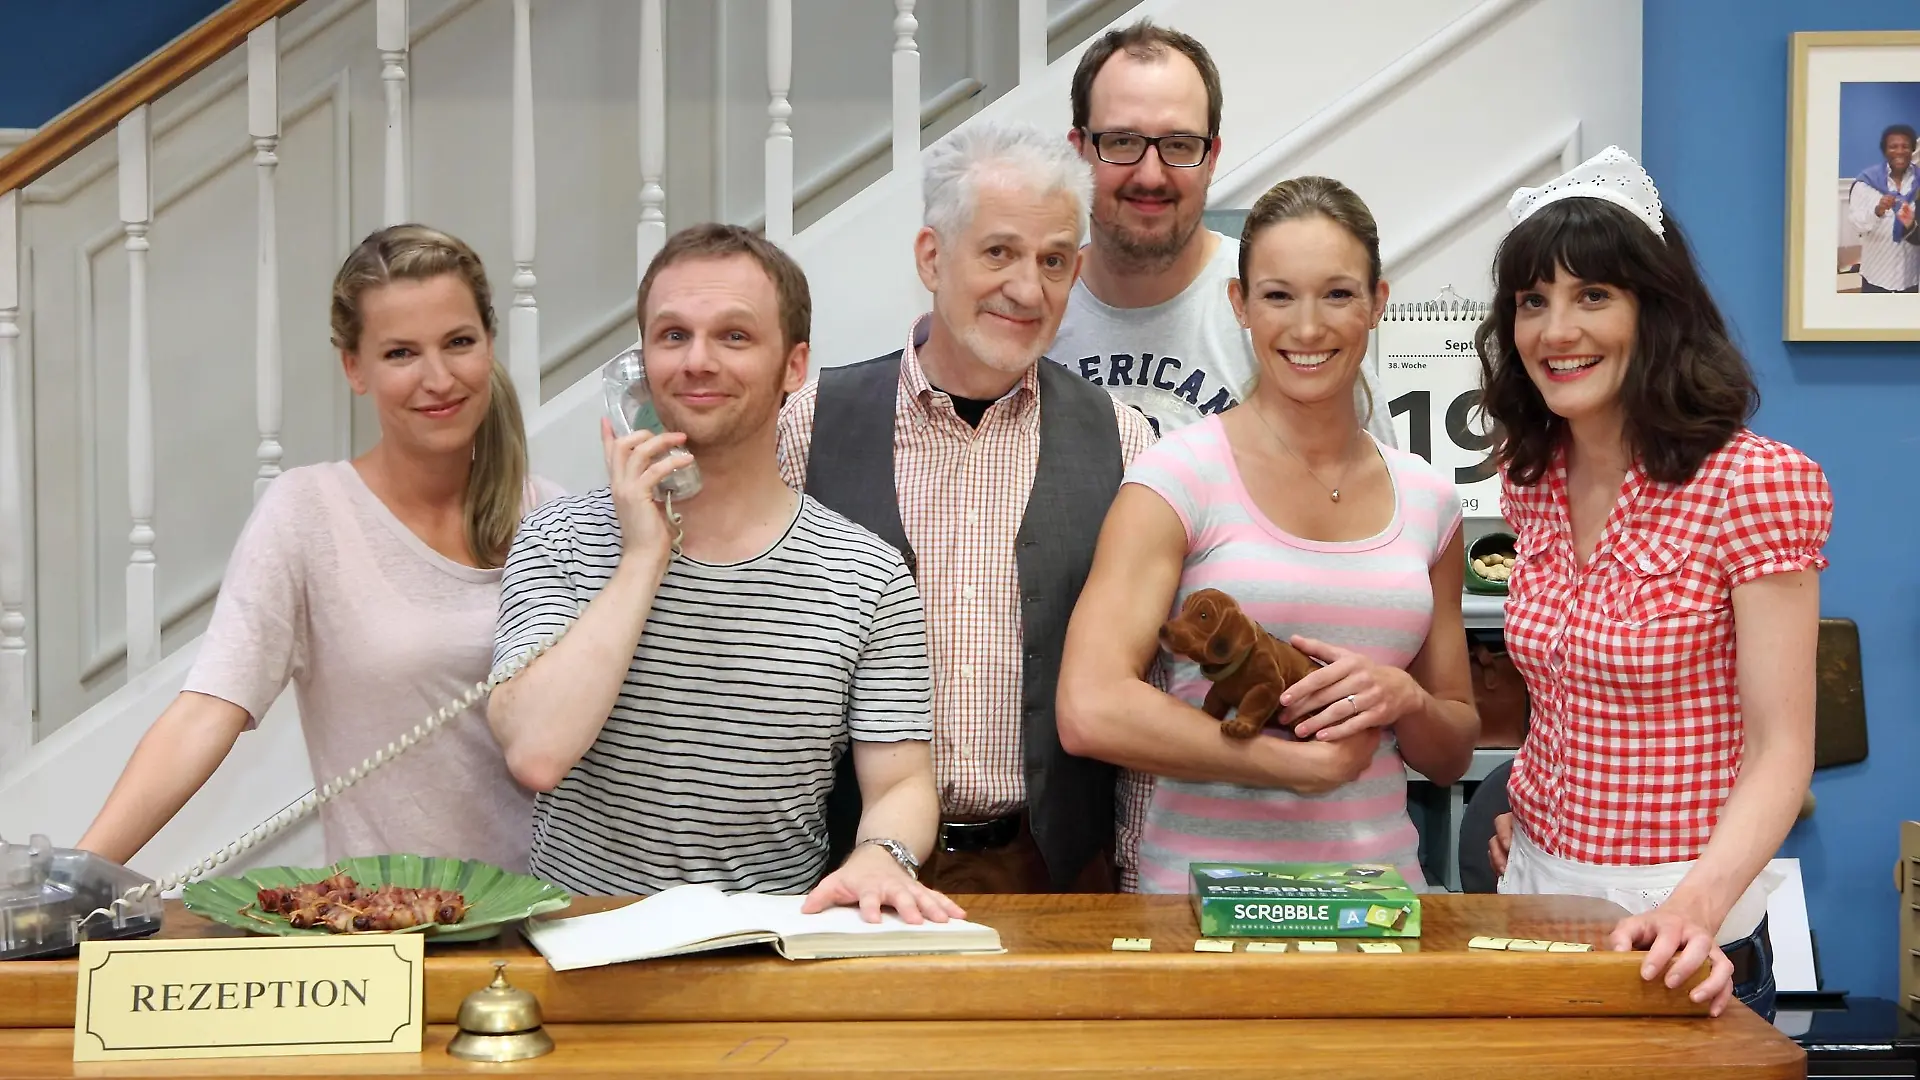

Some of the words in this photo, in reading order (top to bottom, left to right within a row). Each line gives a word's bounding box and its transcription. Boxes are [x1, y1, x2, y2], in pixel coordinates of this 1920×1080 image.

[1445, 339, 1475, 354] Sept
[1388, 362, 1400, 370] 38.
[1401, 362, 1427, 370] Woche
[1063, 353, 1240, 416] ERICAN
[1388, 389, 1499, 484] 19
[1461, 498, 1479, 511] ag
[1234, 904, 1329, 922] SCRABBLE
[1346, 913, 1360, 924] A
[1374, 909, 1388, 922] G
[130, 979, 370, 1012] REZEPTION
